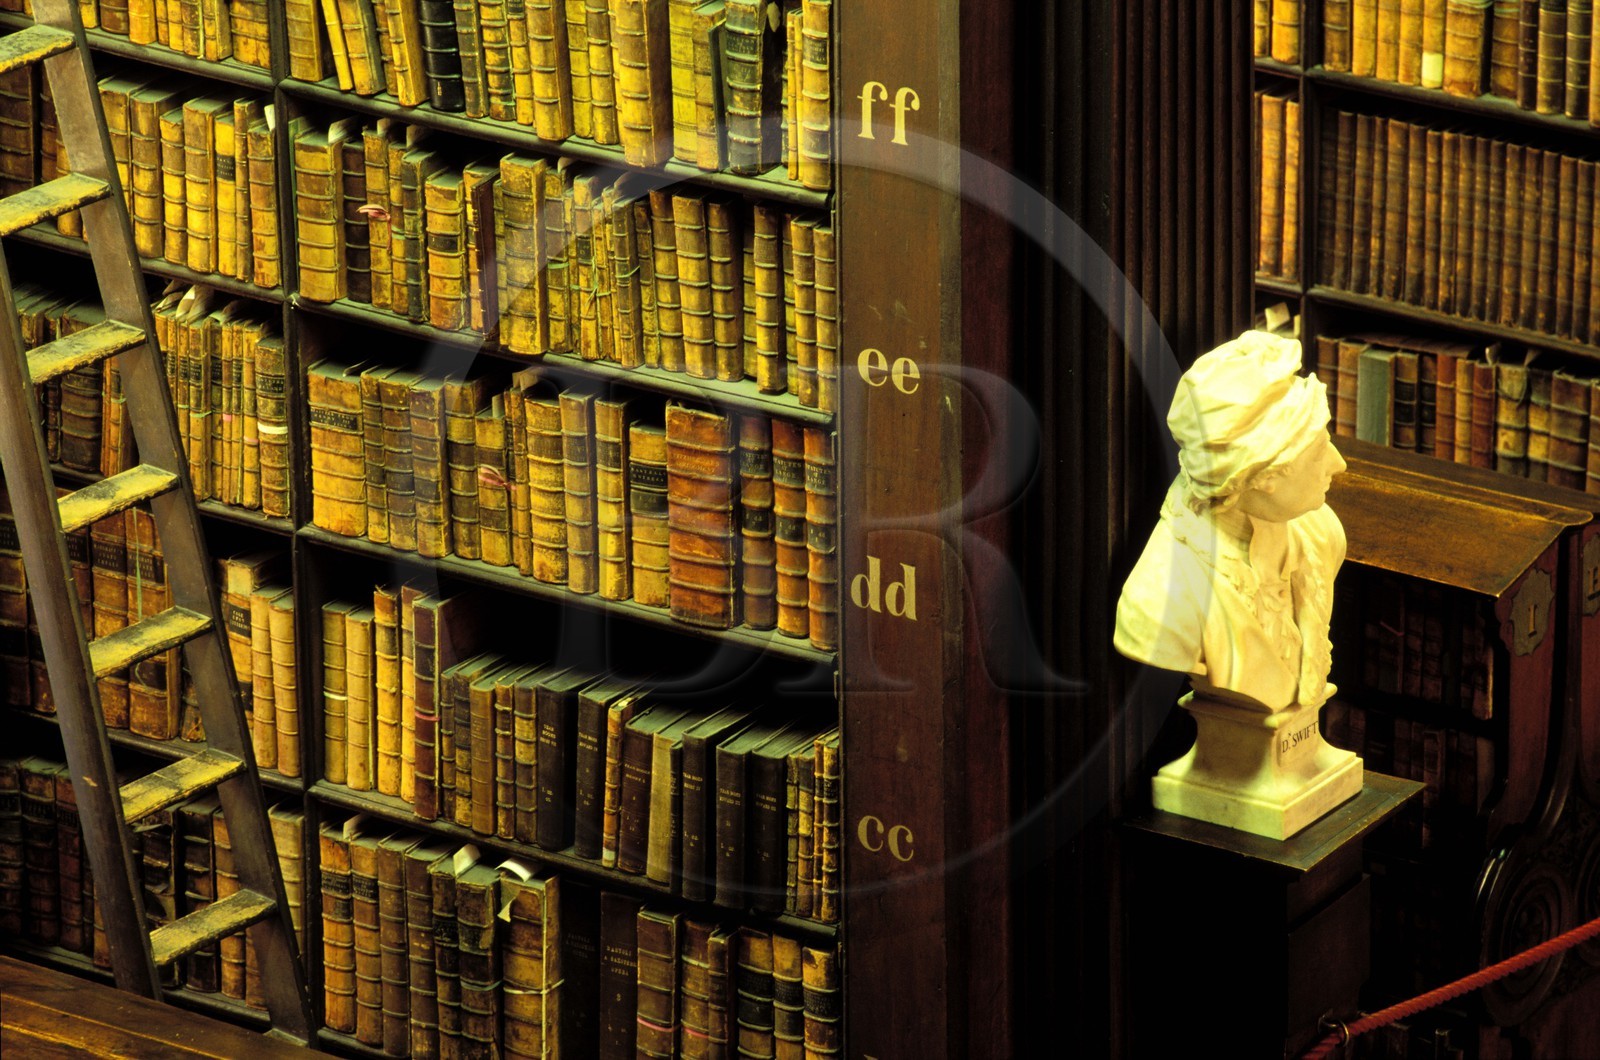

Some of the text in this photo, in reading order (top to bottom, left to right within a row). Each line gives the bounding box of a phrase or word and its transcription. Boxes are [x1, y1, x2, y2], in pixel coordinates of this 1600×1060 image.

[856, 81, 920, 146] ff
[857, 348, 921, 395] ee
[850, 555, 918, 621] dd
[1291, 720, 1319, 748] SWIFT
[857, 815, 914, 862] cc
